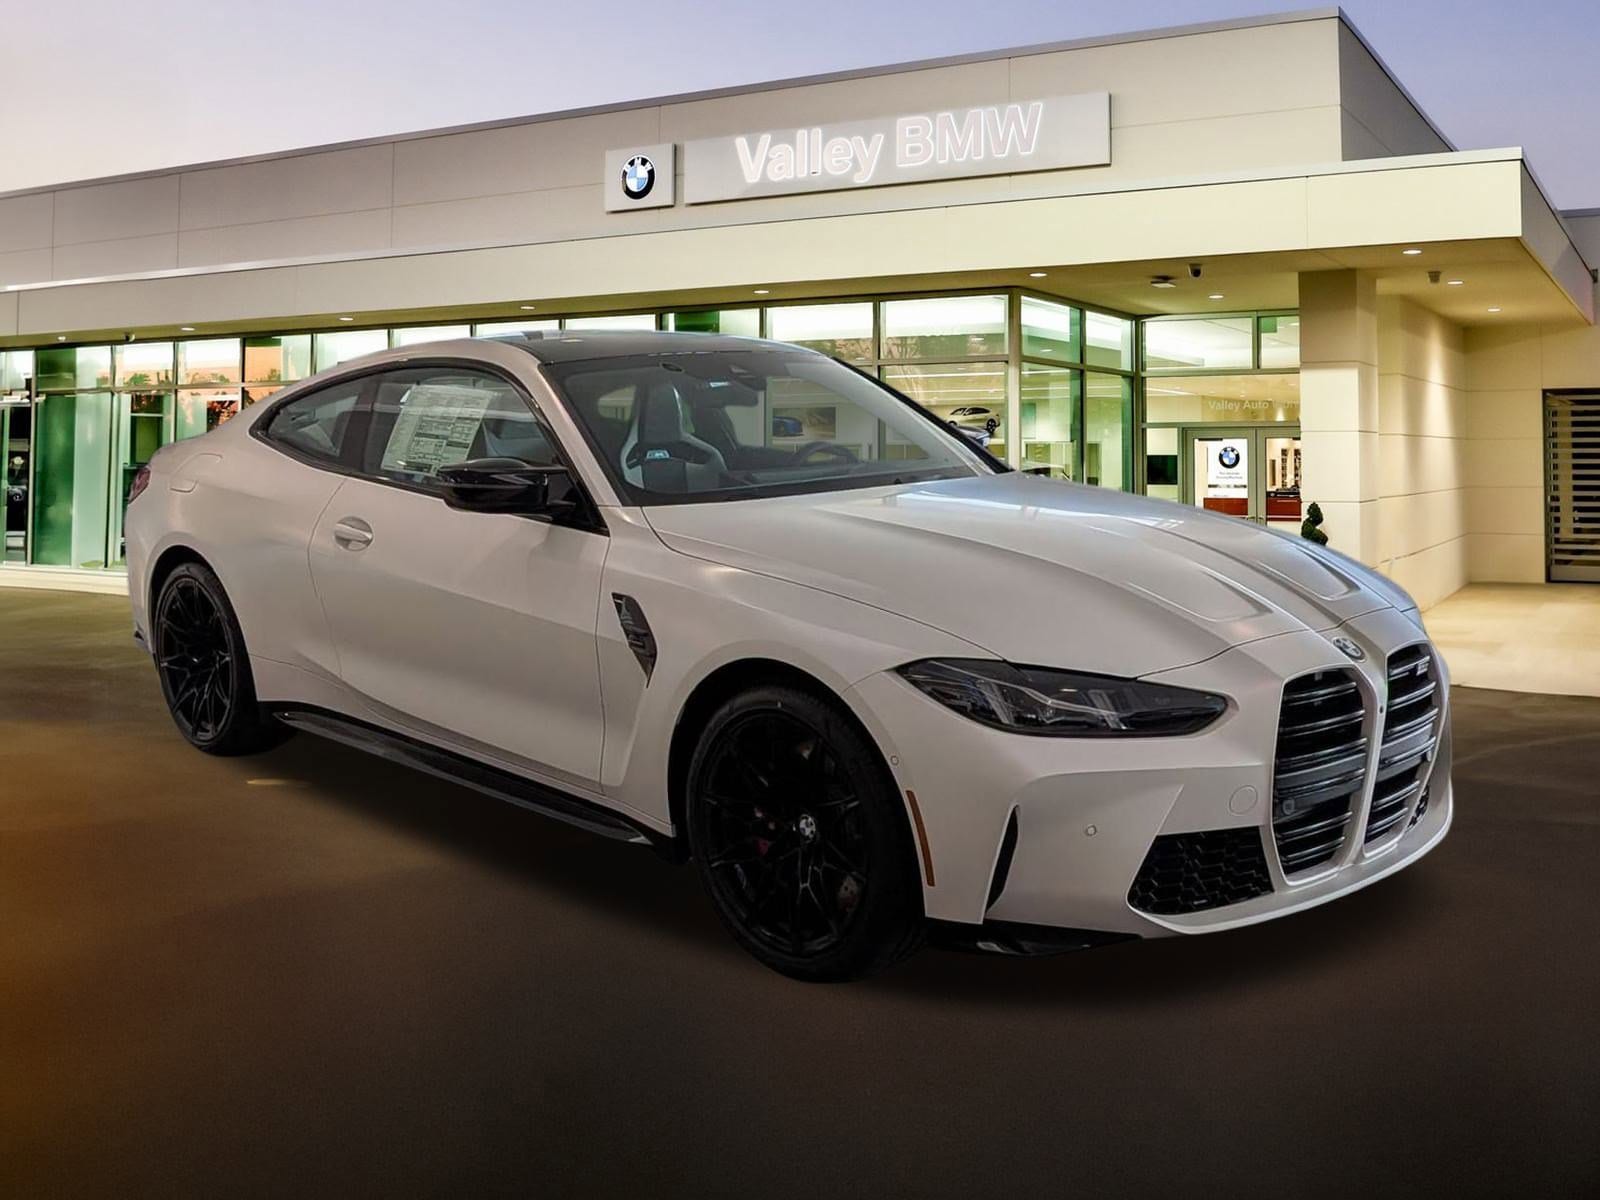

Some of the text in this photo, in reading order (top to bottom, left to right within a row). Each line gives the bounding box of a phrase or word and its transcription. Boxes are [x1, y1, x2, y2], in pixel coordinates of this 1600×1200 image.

[735, 101, 1044, 185] Valley BMW
[1208, 400, 1241, 412] Valley
[1242, 400, 1270, 410] Auto
